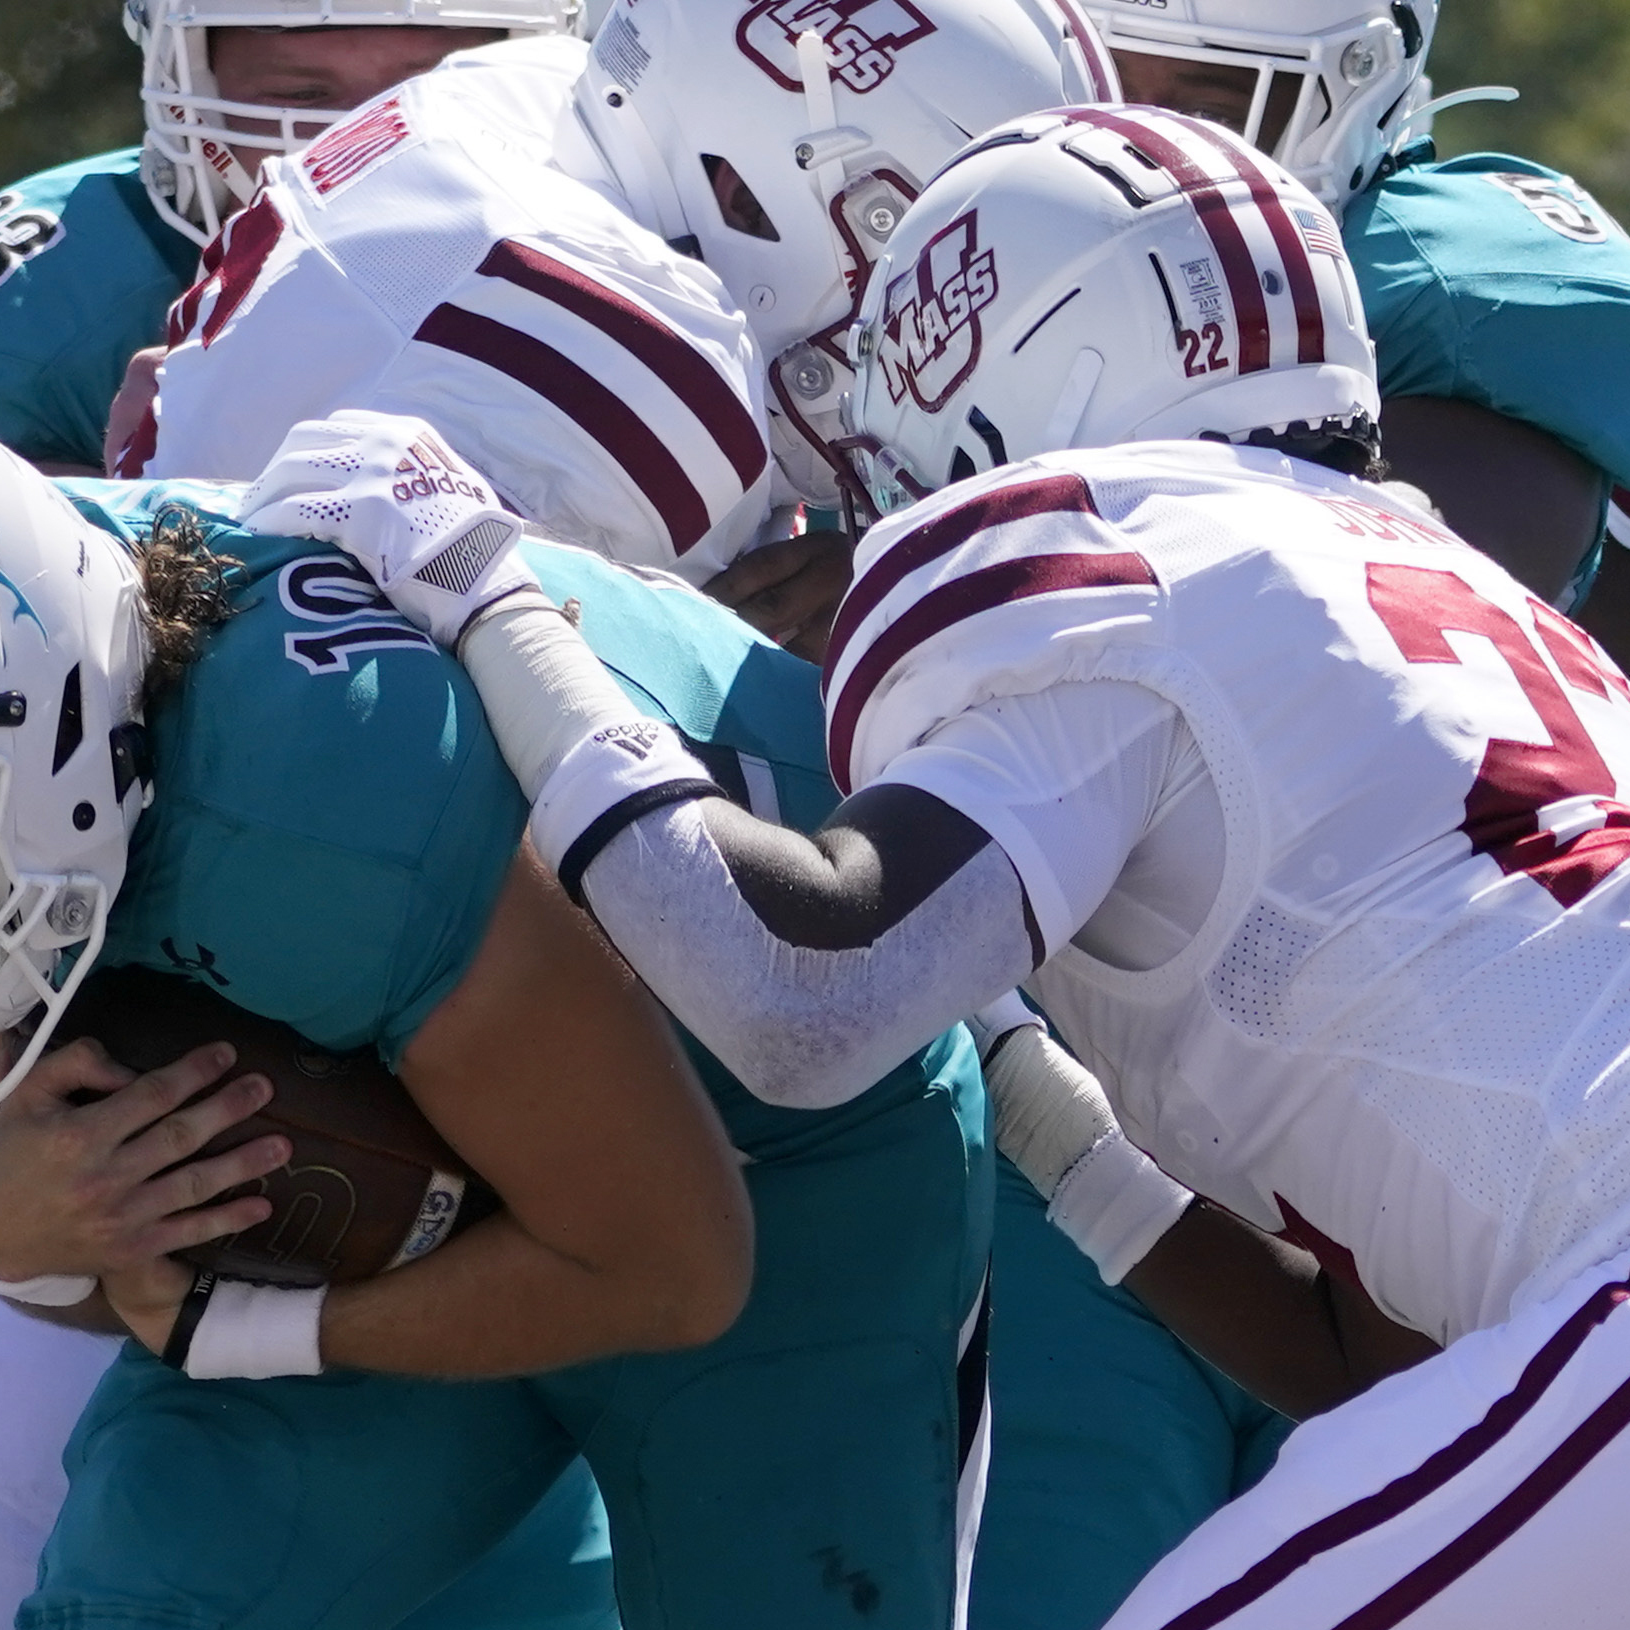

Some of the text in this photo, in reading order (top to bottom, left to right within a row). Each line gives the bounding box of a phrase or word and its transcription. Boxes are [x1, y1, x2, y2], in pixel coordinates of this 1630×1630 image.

[877, 246, 1000, 406] MASS
[1178, 321, 1230, 378] 22
[392, 471, 487, 505] adidas
[278, 555, 440, 676] 10
